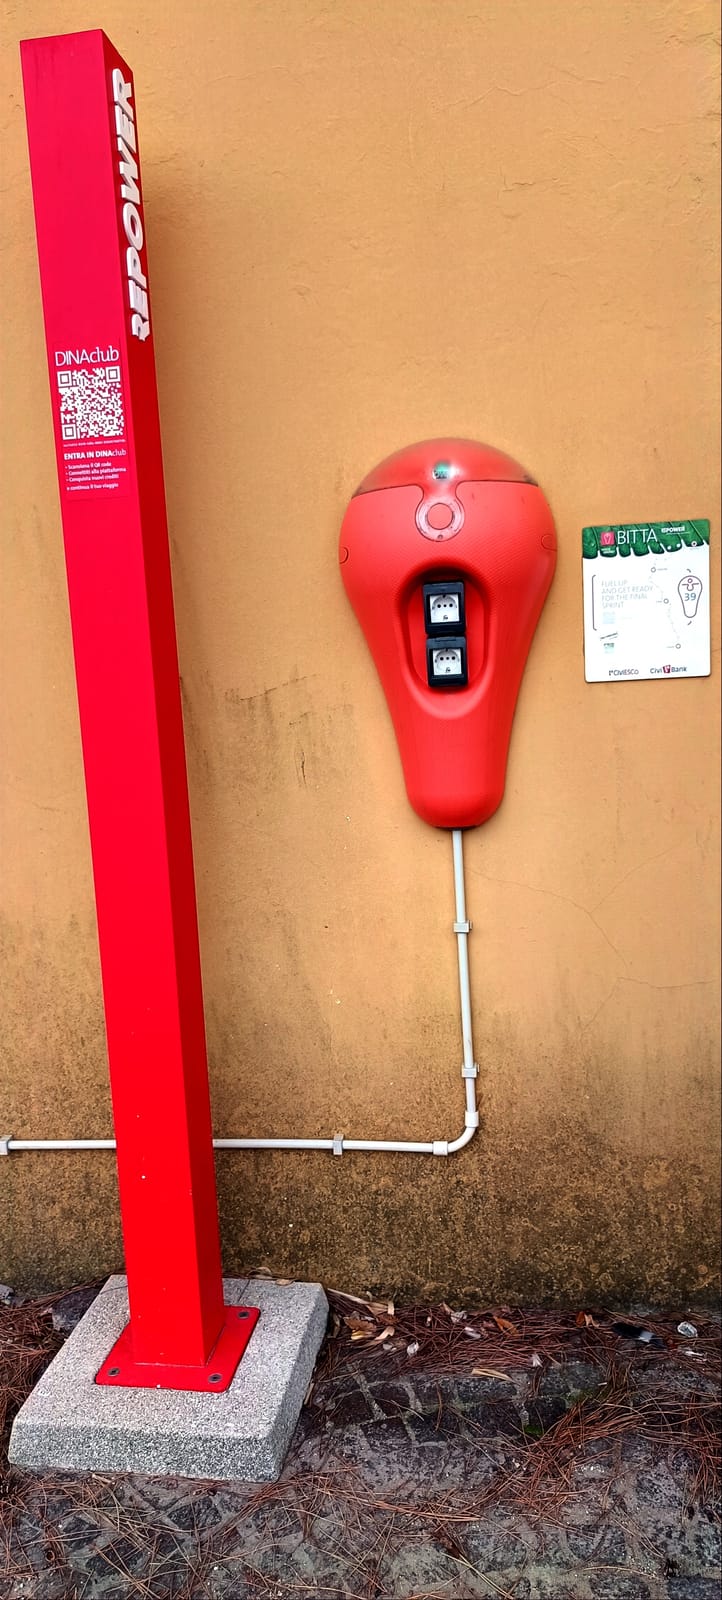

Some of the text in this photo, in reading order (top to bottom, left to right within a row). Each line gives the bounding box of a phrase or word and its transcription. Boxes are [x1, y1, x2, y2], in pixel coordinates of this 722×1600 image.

[112, 68, 150, 342] REPOWER
[55, 345, 120, 366] DINAclub
[64, 452, 86, 460] ENTRA
[95, 448, 127, 457] DINAclub
[617, 528, 658, 545] BITTA
[629, 592, 648, 600] FINAL
[684, 592, 697, 601] 39
[602, 601, 624, 609] SPRINT
